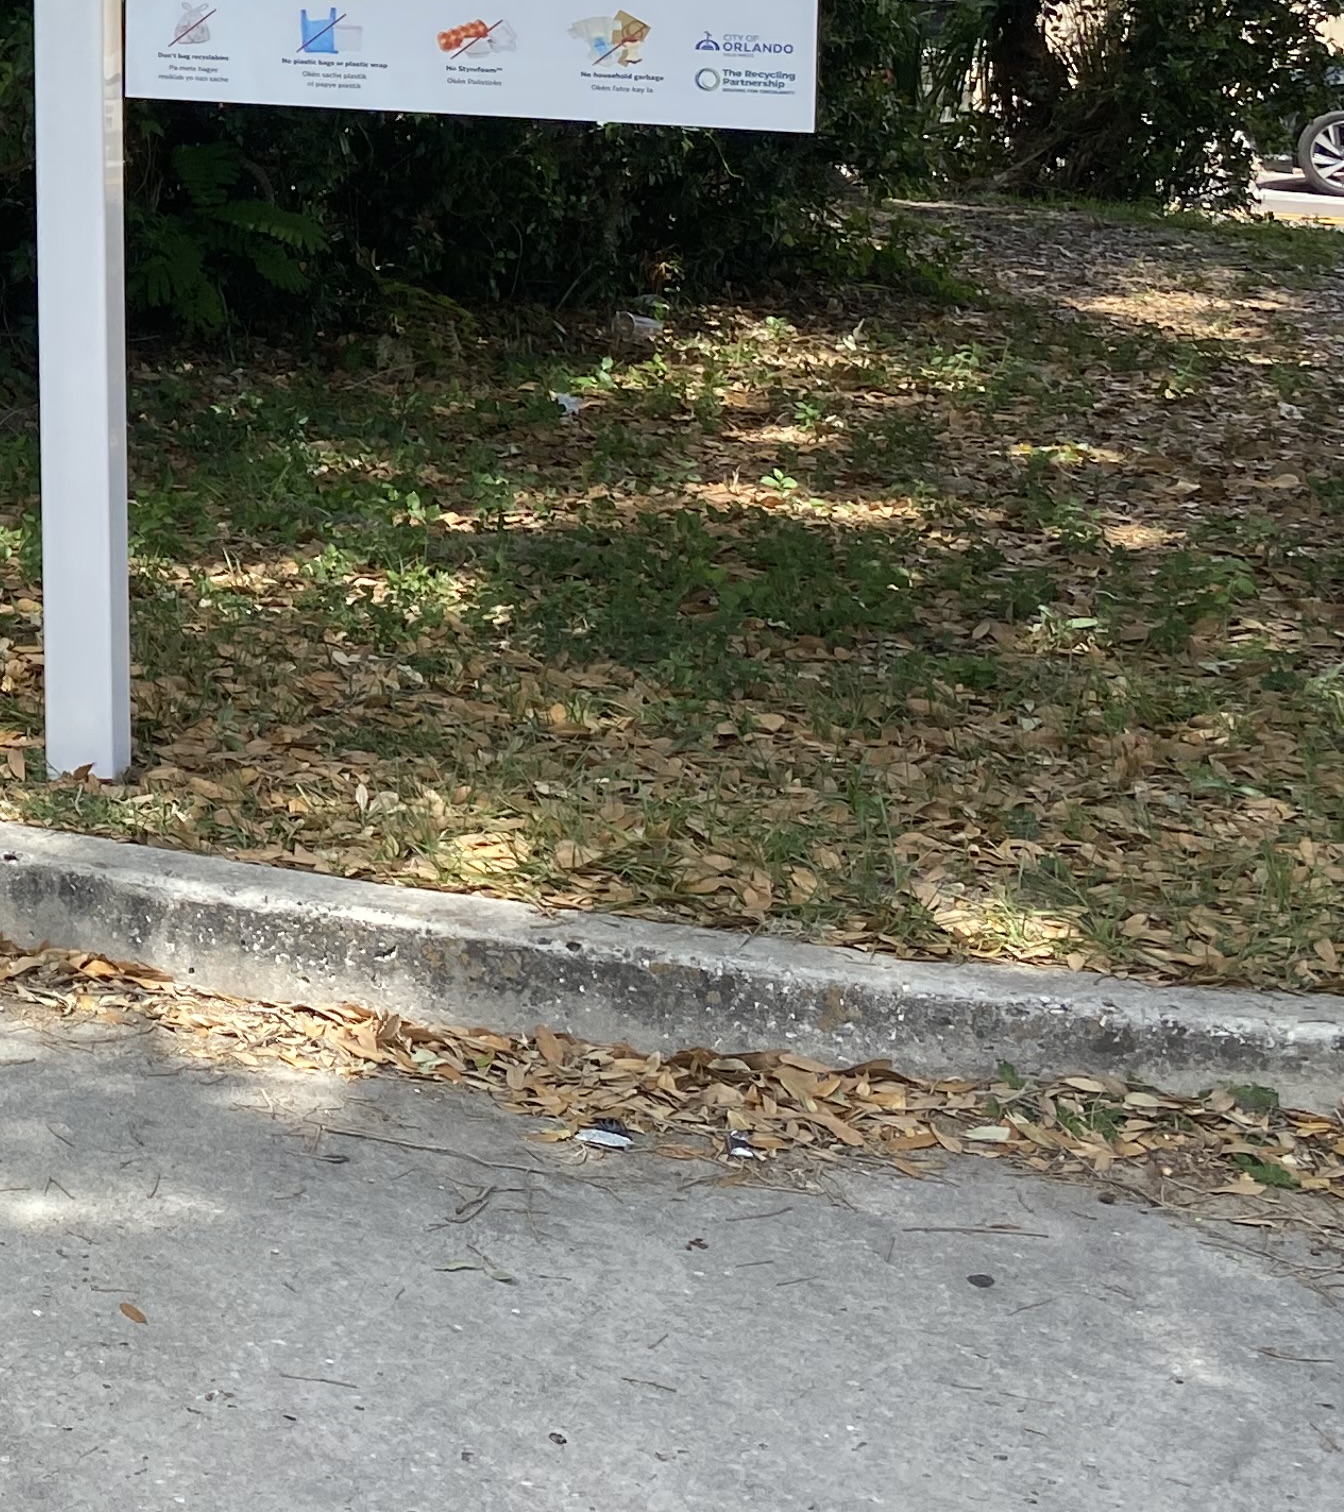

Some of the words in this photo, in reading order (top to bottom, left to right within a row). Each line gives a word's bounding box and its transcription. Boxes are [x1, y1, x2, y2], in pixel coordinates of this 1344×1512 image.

[723, 33, 745, 42] CITY
[746, 34, 759, 42] OF
[723, 42, 794, 54] ORLANDO
[722, 68, 742, 78] The
[745, 69, 796, 82] Recycling
[722, 77, 785, 89] Partnership
